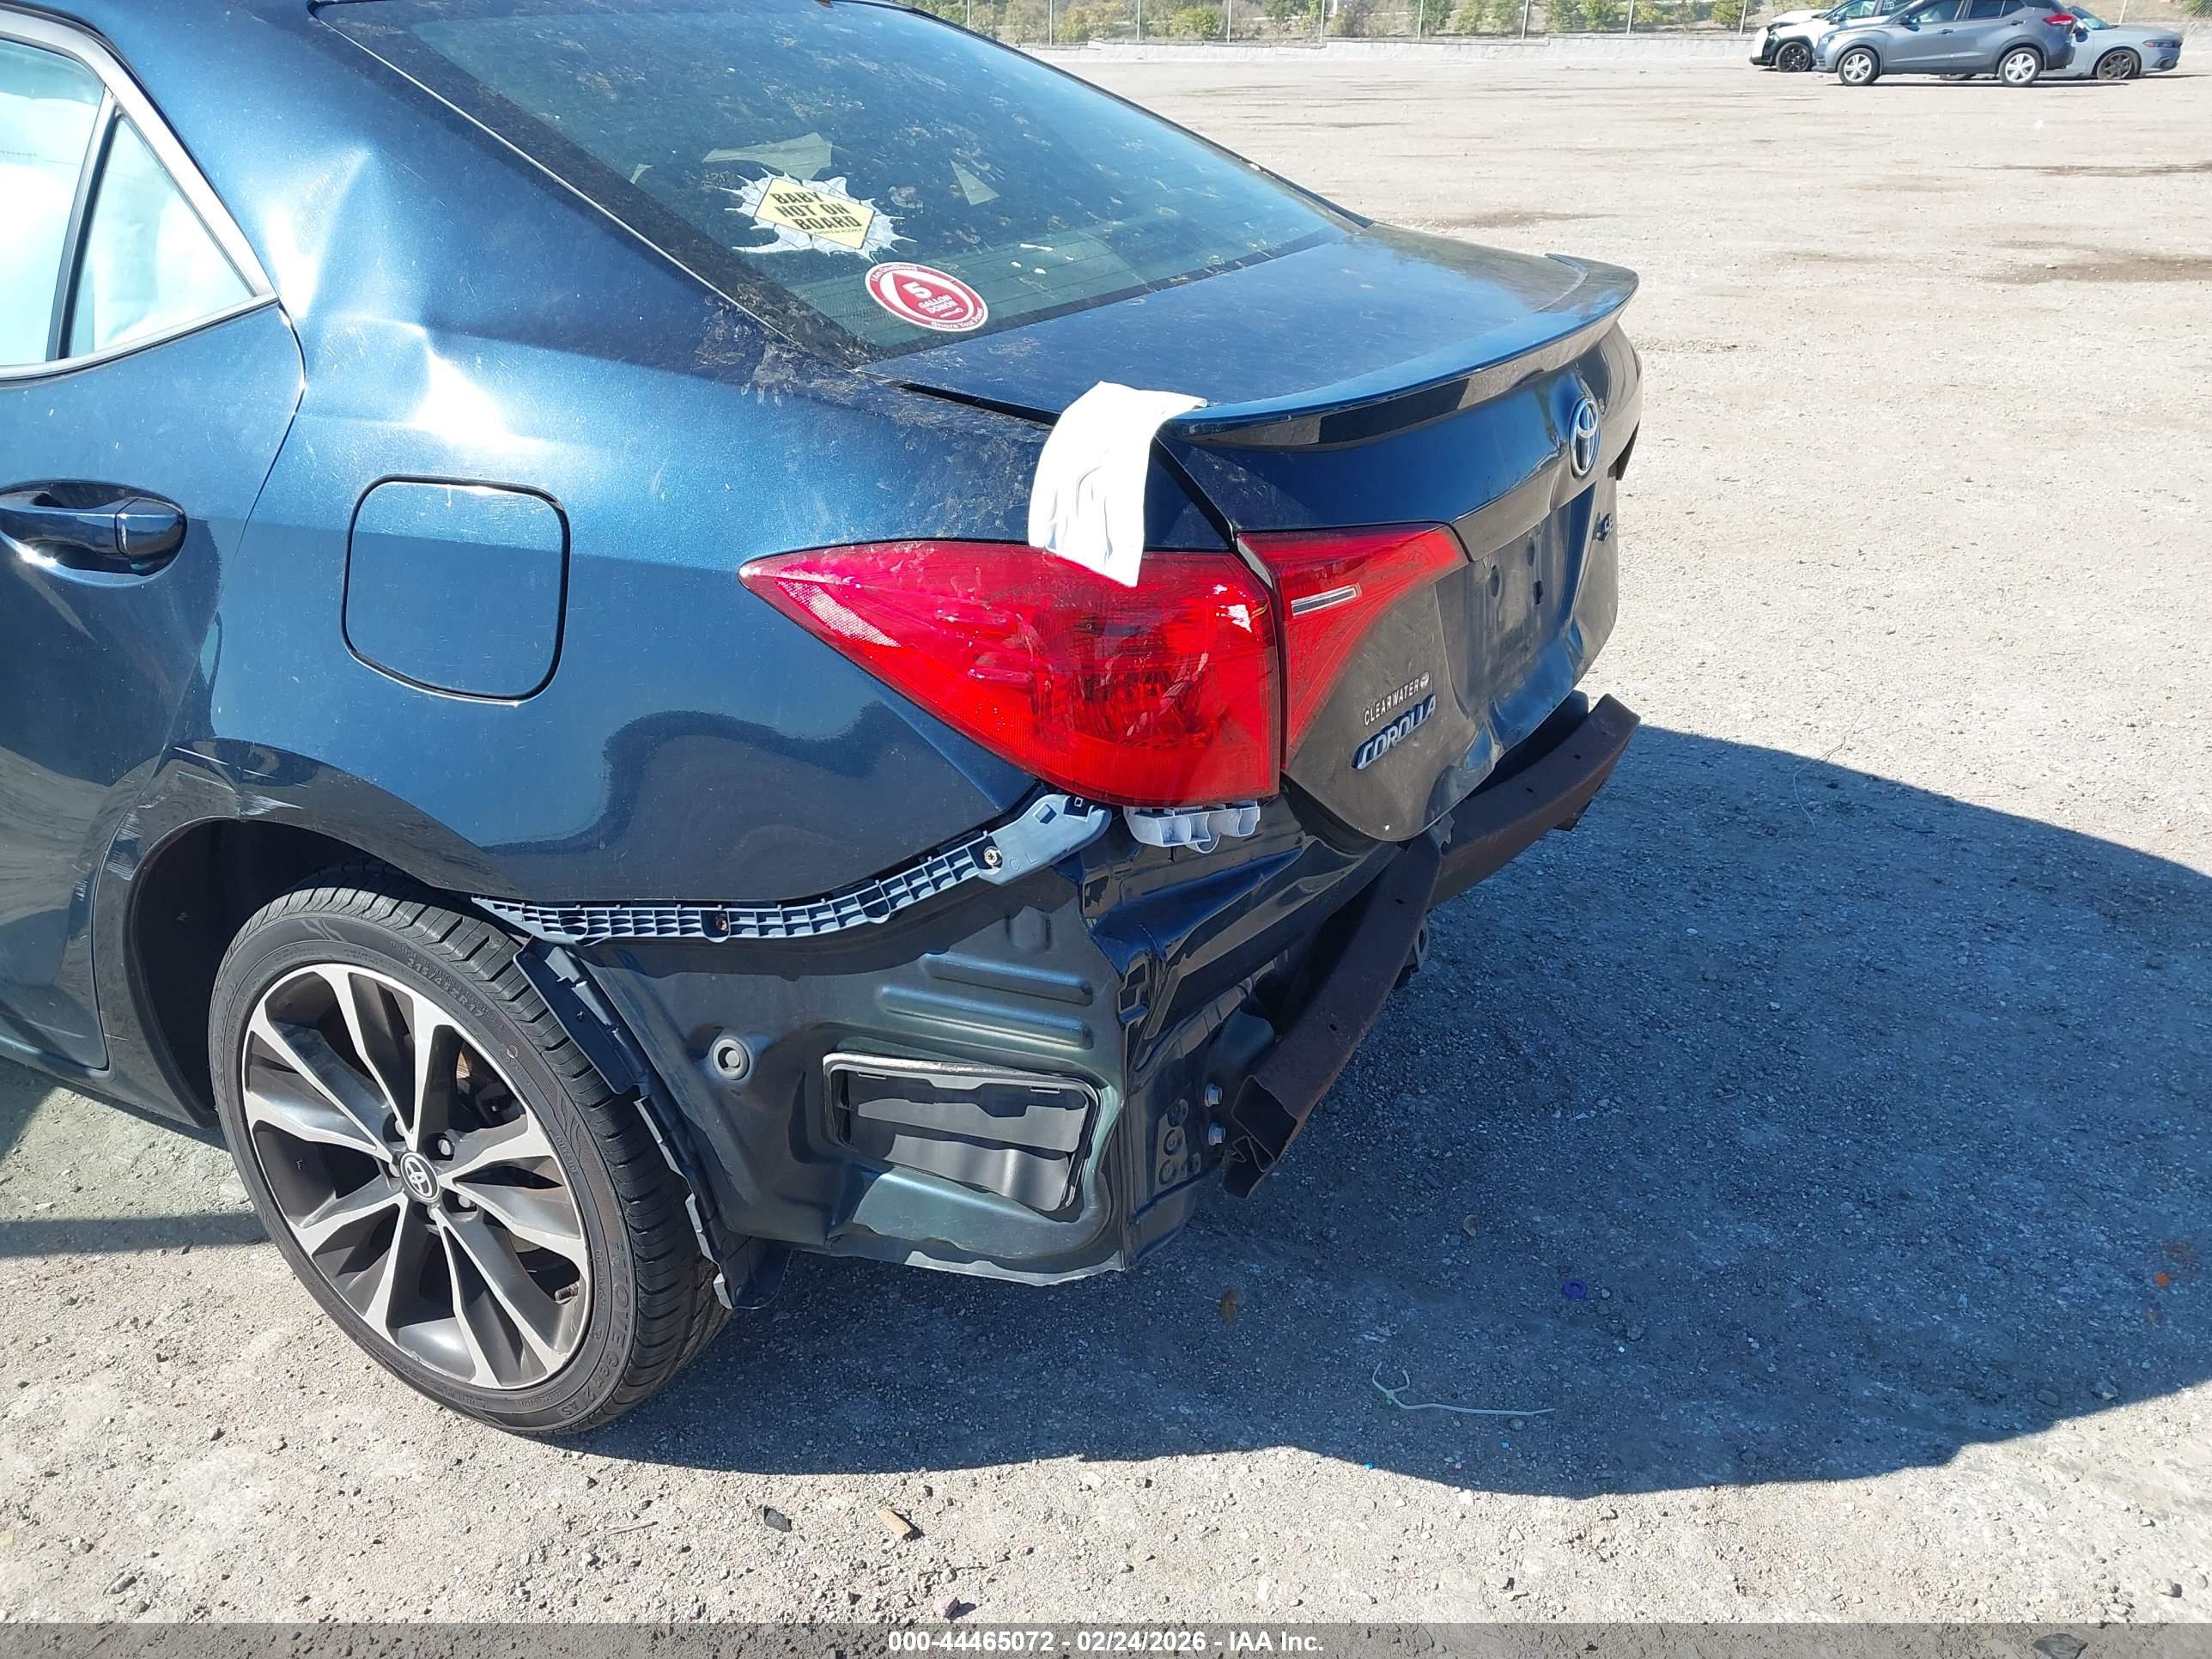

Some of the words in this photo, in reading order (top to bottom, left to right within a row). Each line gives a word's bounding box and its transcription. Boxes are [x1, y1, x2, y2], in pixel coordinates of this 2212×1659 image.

[770, 191, 824, 204] BABY
[775, 205, 817, 217] NOT
[819, 204, 852, 215] ON
[791, 216, 863, 230] BOARD
[902, 281, 933, 299] 5
[918, 294, 953, 309] GALLON
[927, 300, 958, 314] DONOR
[1363, 678, 1420, 726] CLEARWATER
[1352, 694, 1437, 770] COROLLA
